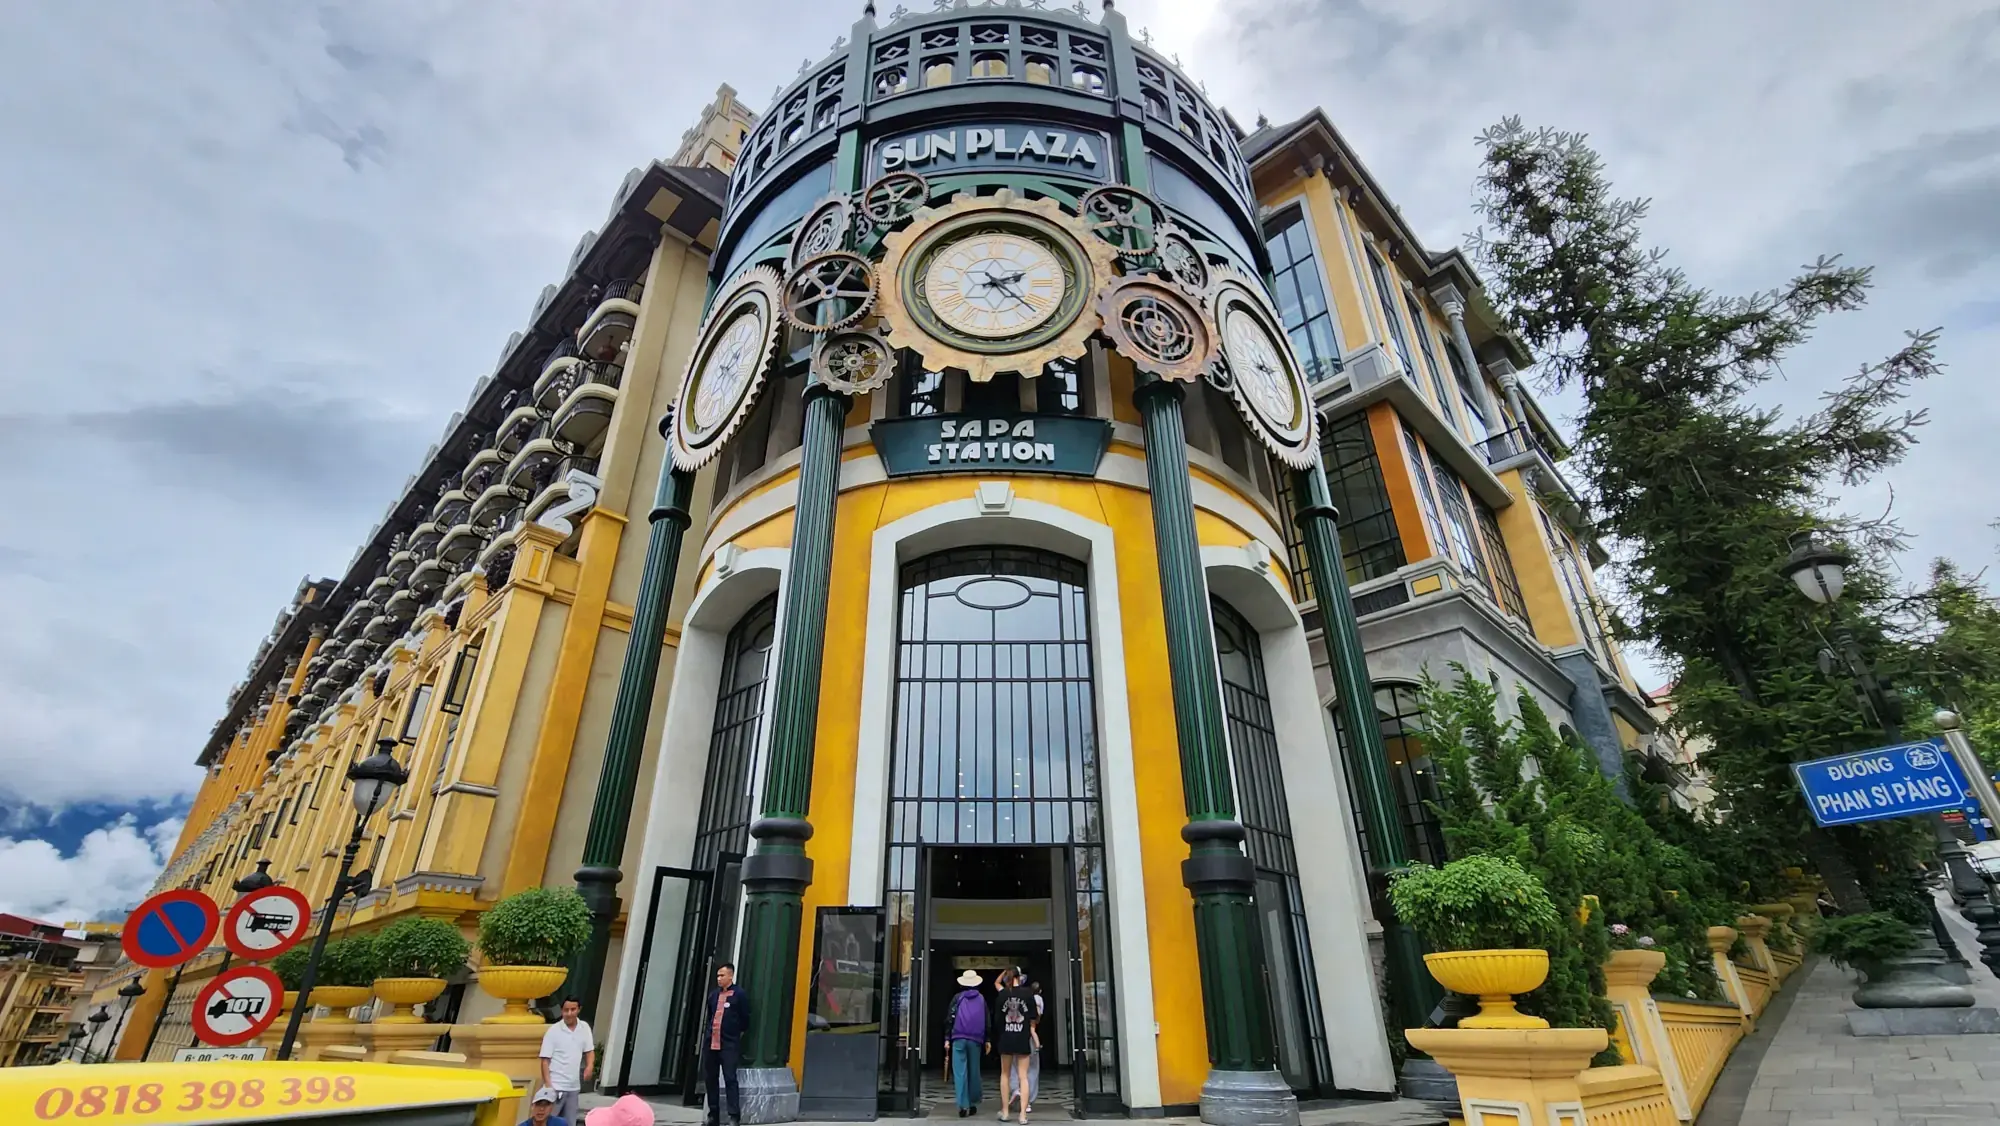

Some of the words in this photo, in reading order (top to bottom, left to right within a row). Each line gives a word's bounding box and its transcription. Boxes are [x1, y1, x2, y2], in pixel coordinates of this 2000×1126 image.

[881, 131, 956, 168] SUN
[966, 128, 1097, 166] PLAZA
[940, 419, 1035, 438] SAPA
[928, 442, 1055, 461] STATION
[1827, 757, 1895, 781] ĐƯỜNG
[1816, 789, 1872, 815] PHAN
[1891, 776, 1951, 804] PĂNG
[225, 998, 263, 1012] 10T
[34, 1083, 164, 1120] 0818
[176, 1079, 265, 1112] 398
[277, 1076, 356, 1106] 398
